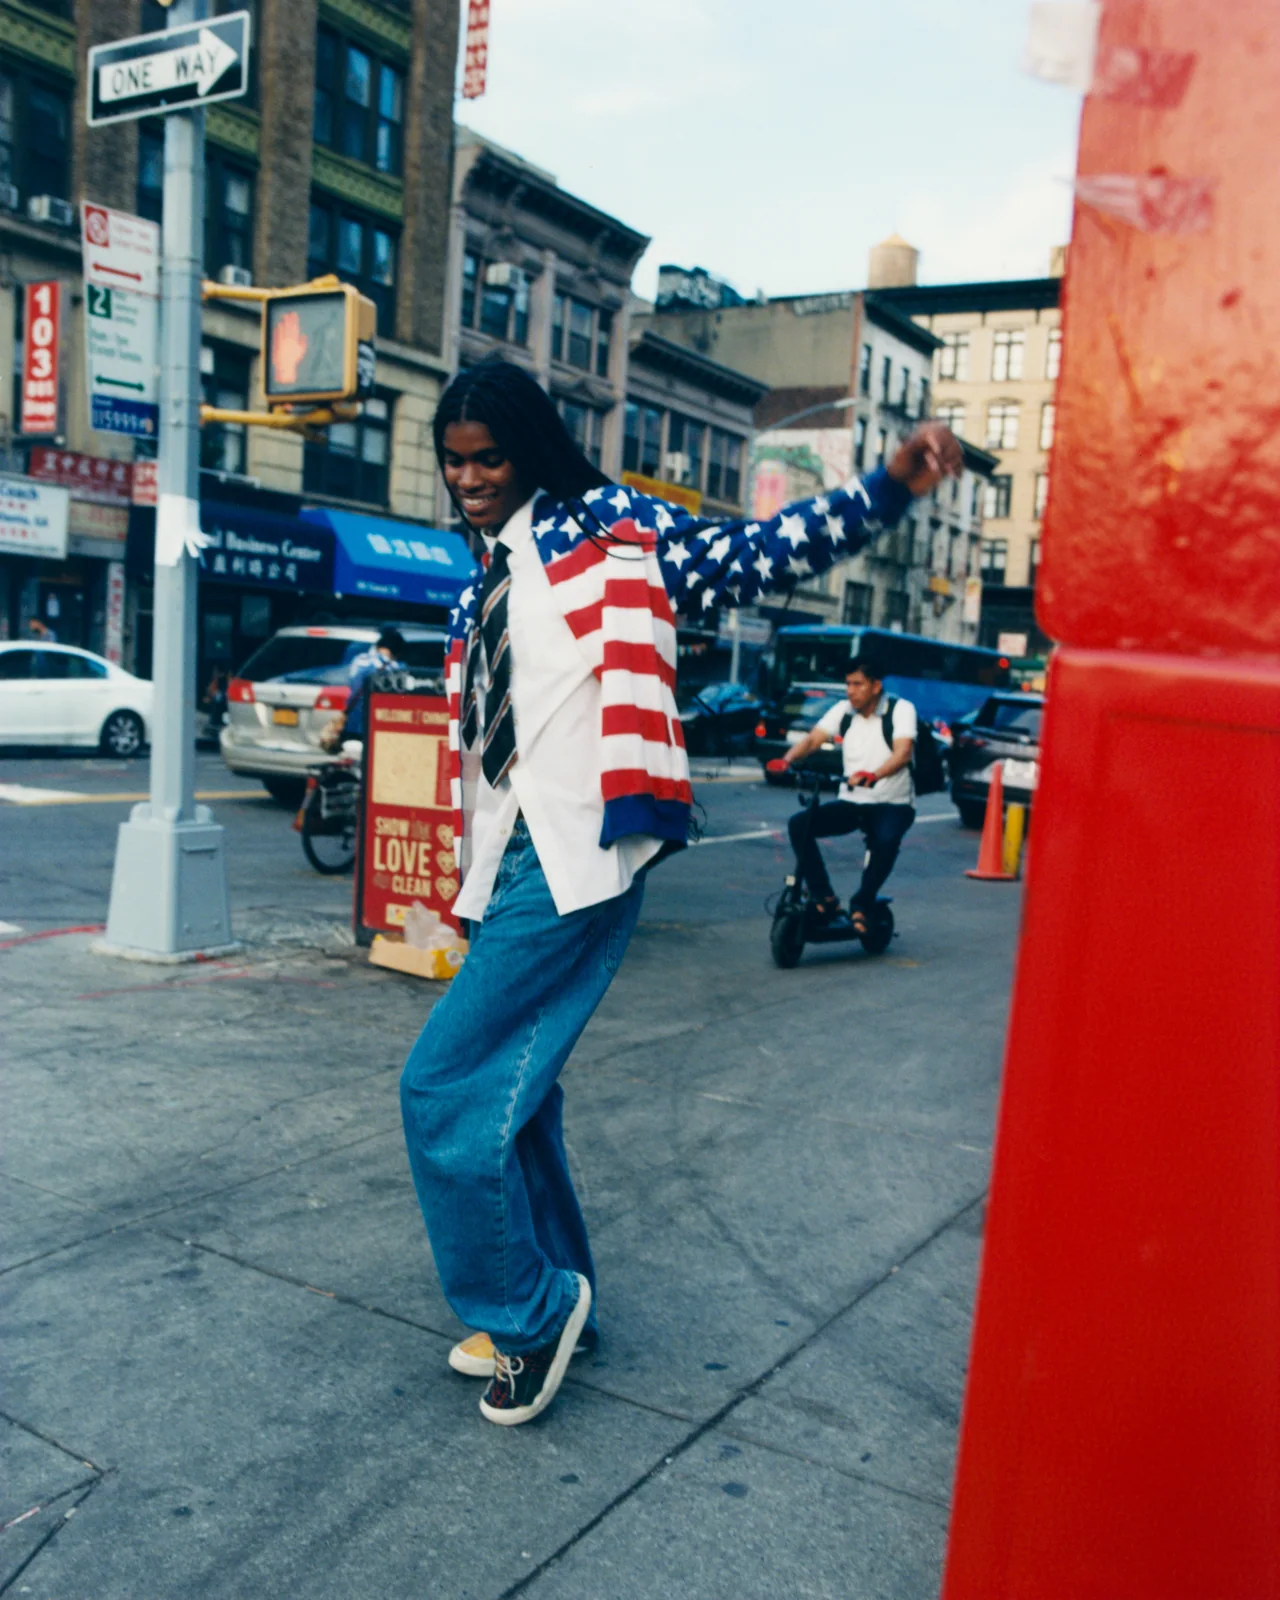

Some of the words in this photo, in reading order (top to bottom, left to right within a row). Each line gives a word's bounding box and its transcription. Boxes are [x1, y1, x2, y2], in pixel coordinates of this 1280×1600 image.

[111, 61, 153, 96] ONE
[174, 46, 221, 81] WAY
[93, 287, 108, 315] 2
[31, 285, 53, 378] 103
[225, 529, 279, 555] Business
[374, 816, 410, 838] SHOW
[373, 836, 432, 878] LOVE
[391, 874, 431, 898] CLEAN
